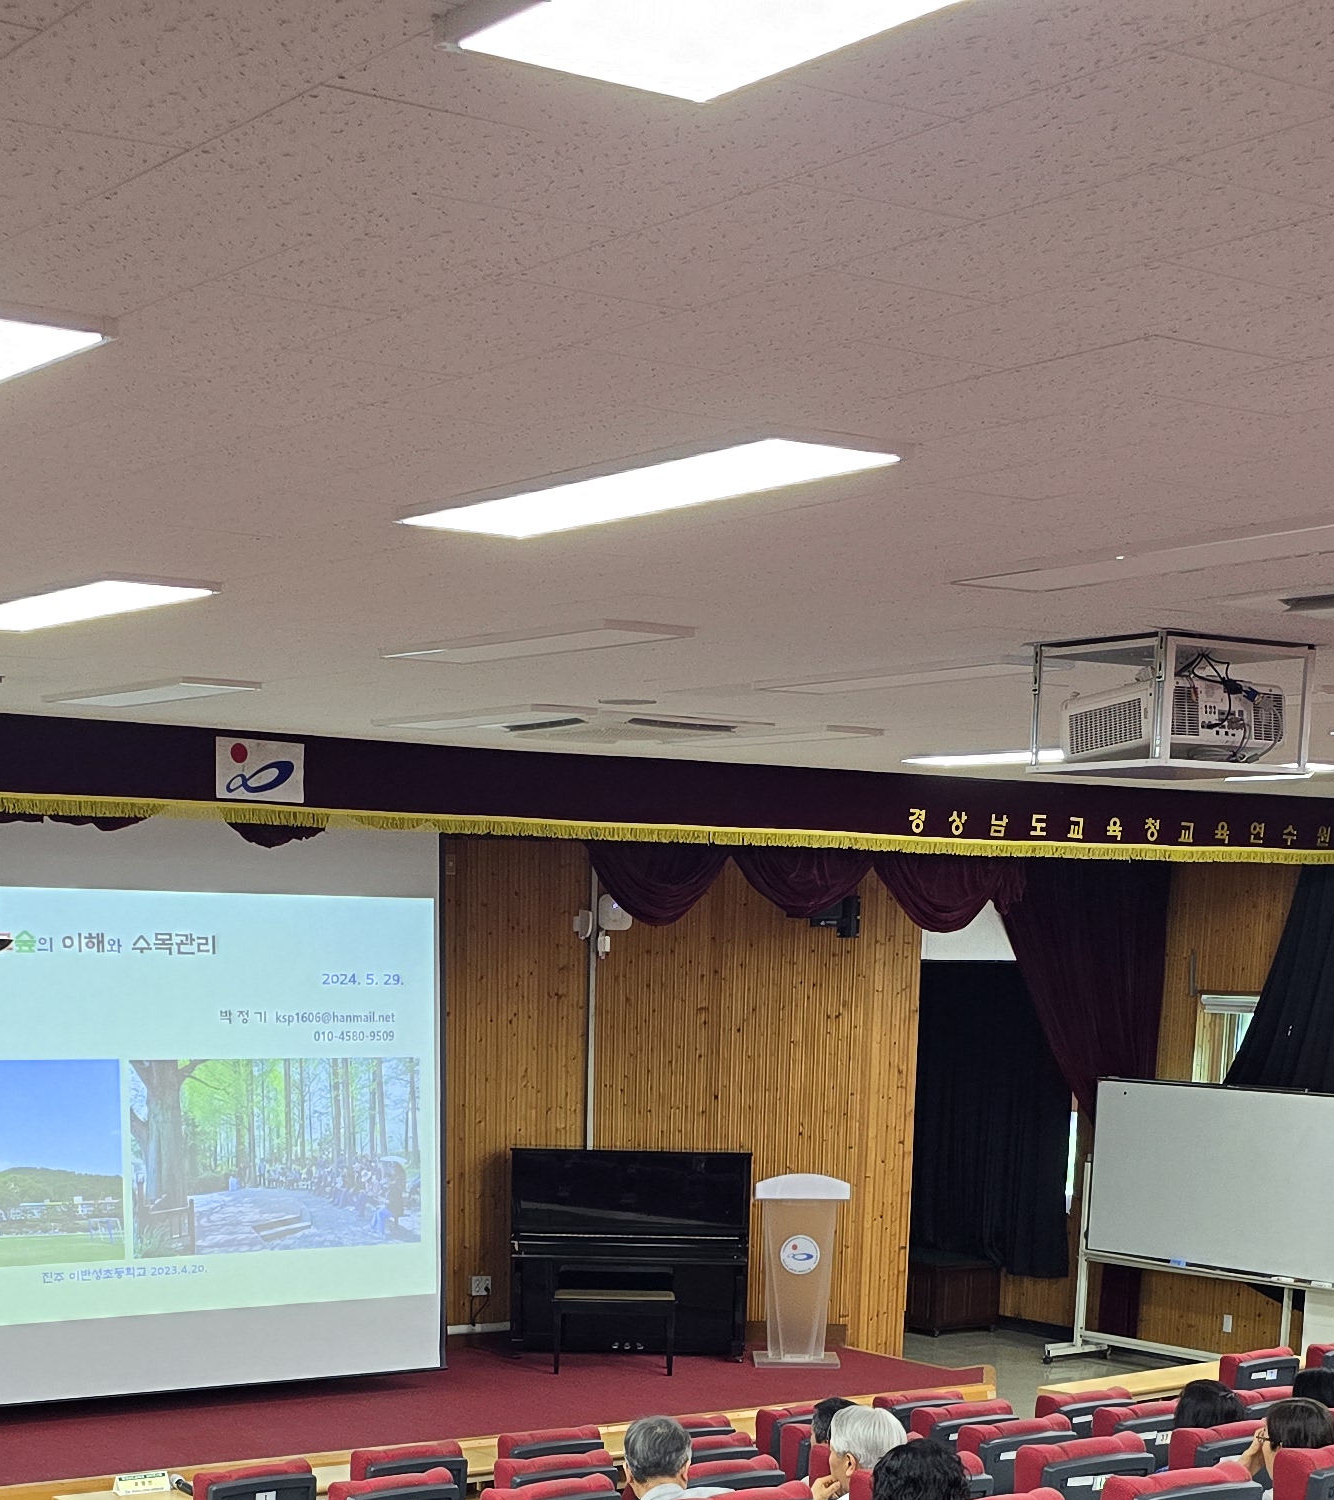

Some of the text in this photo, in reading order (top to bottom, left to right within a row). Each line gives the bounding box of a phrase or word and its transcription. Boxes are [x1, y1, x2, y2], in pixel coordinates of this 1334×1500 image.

[61, 932, 122, 953] 이해와
[131, 932, 217, 955] 수목관리
[321, 973, 405, 986] 2024. 5. 29.
[275, 1011, 396, 1026] ksp1606@hanmail.net
[313, 1030, 395, 1042] 010-4580-9509
[150, 1264, 208, 1277] 2023.4.20.
